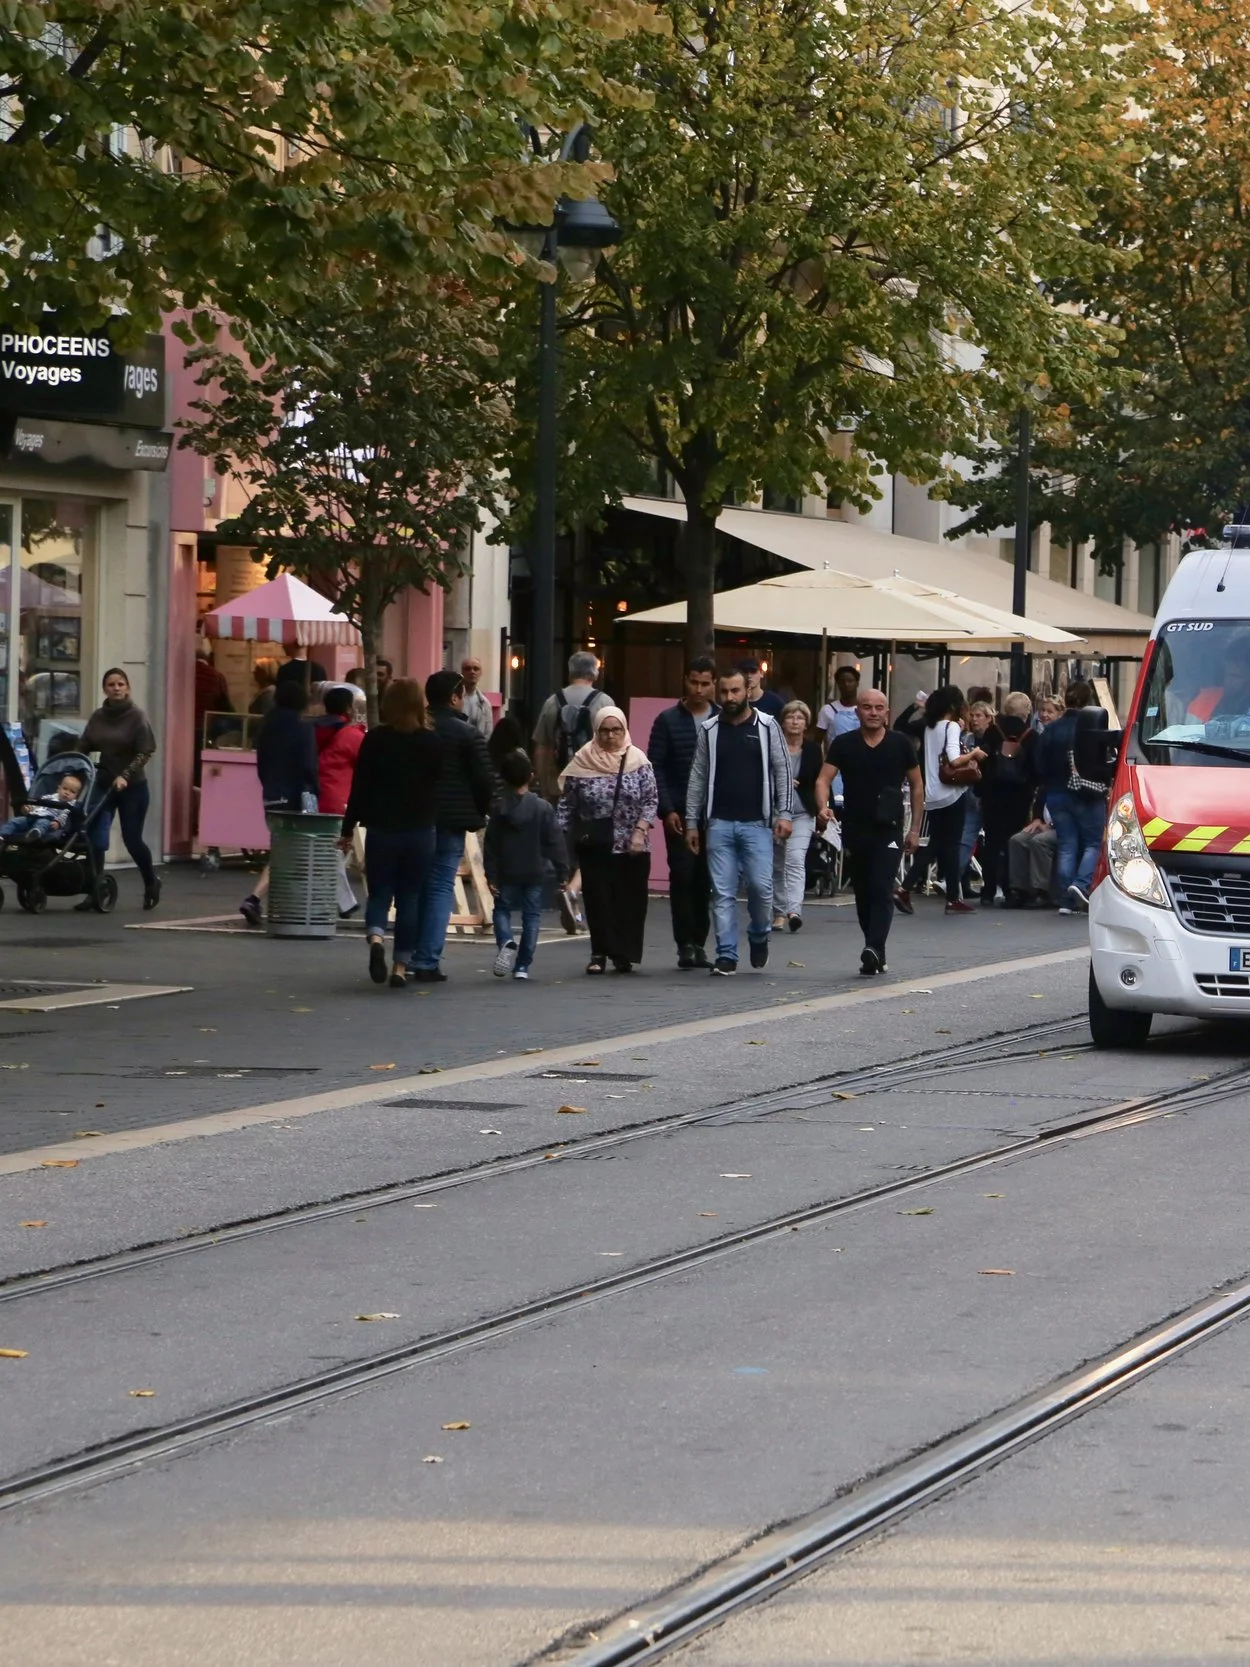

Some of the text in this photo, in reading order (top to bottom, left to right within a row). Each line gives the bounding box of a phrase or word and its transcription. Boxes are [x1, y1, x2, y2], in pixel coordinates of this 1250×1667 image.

[1, 334, 110, 357] PHOCEENS
[2, 360, 82, 386] Voyages
[15, 428, 44, 451] Voyages
[1167, 622, 1213, 632] GT SUD
